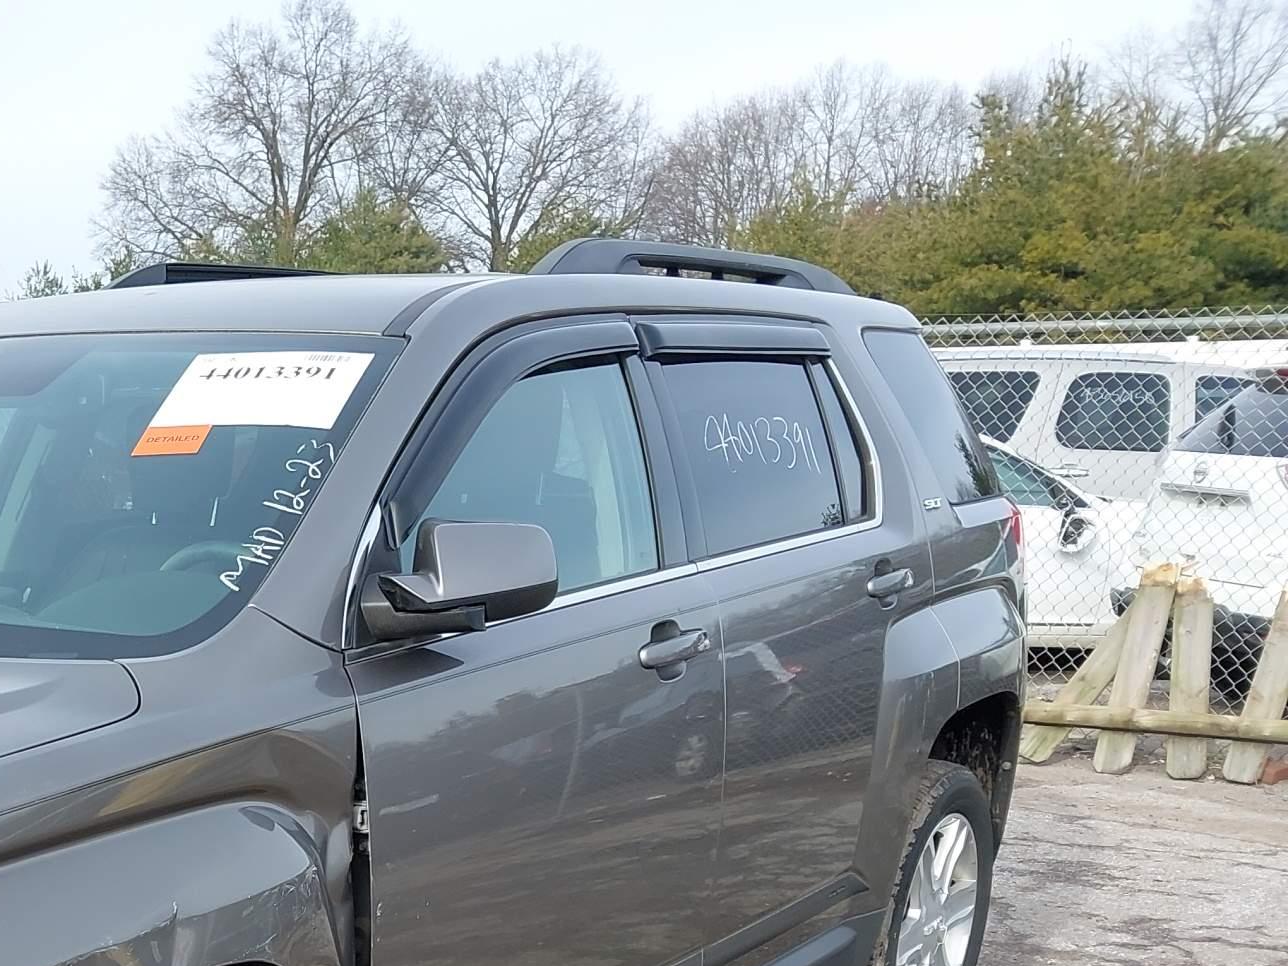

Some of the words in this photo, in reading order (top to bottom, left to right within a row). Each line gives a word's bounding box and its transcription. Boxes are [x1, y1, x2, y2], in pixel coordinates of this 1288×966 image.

[198, 365, 338, 382] 44013391
[146, 433, 201, 445] DETAILED
[704, 413, 822, 474] 44013391
